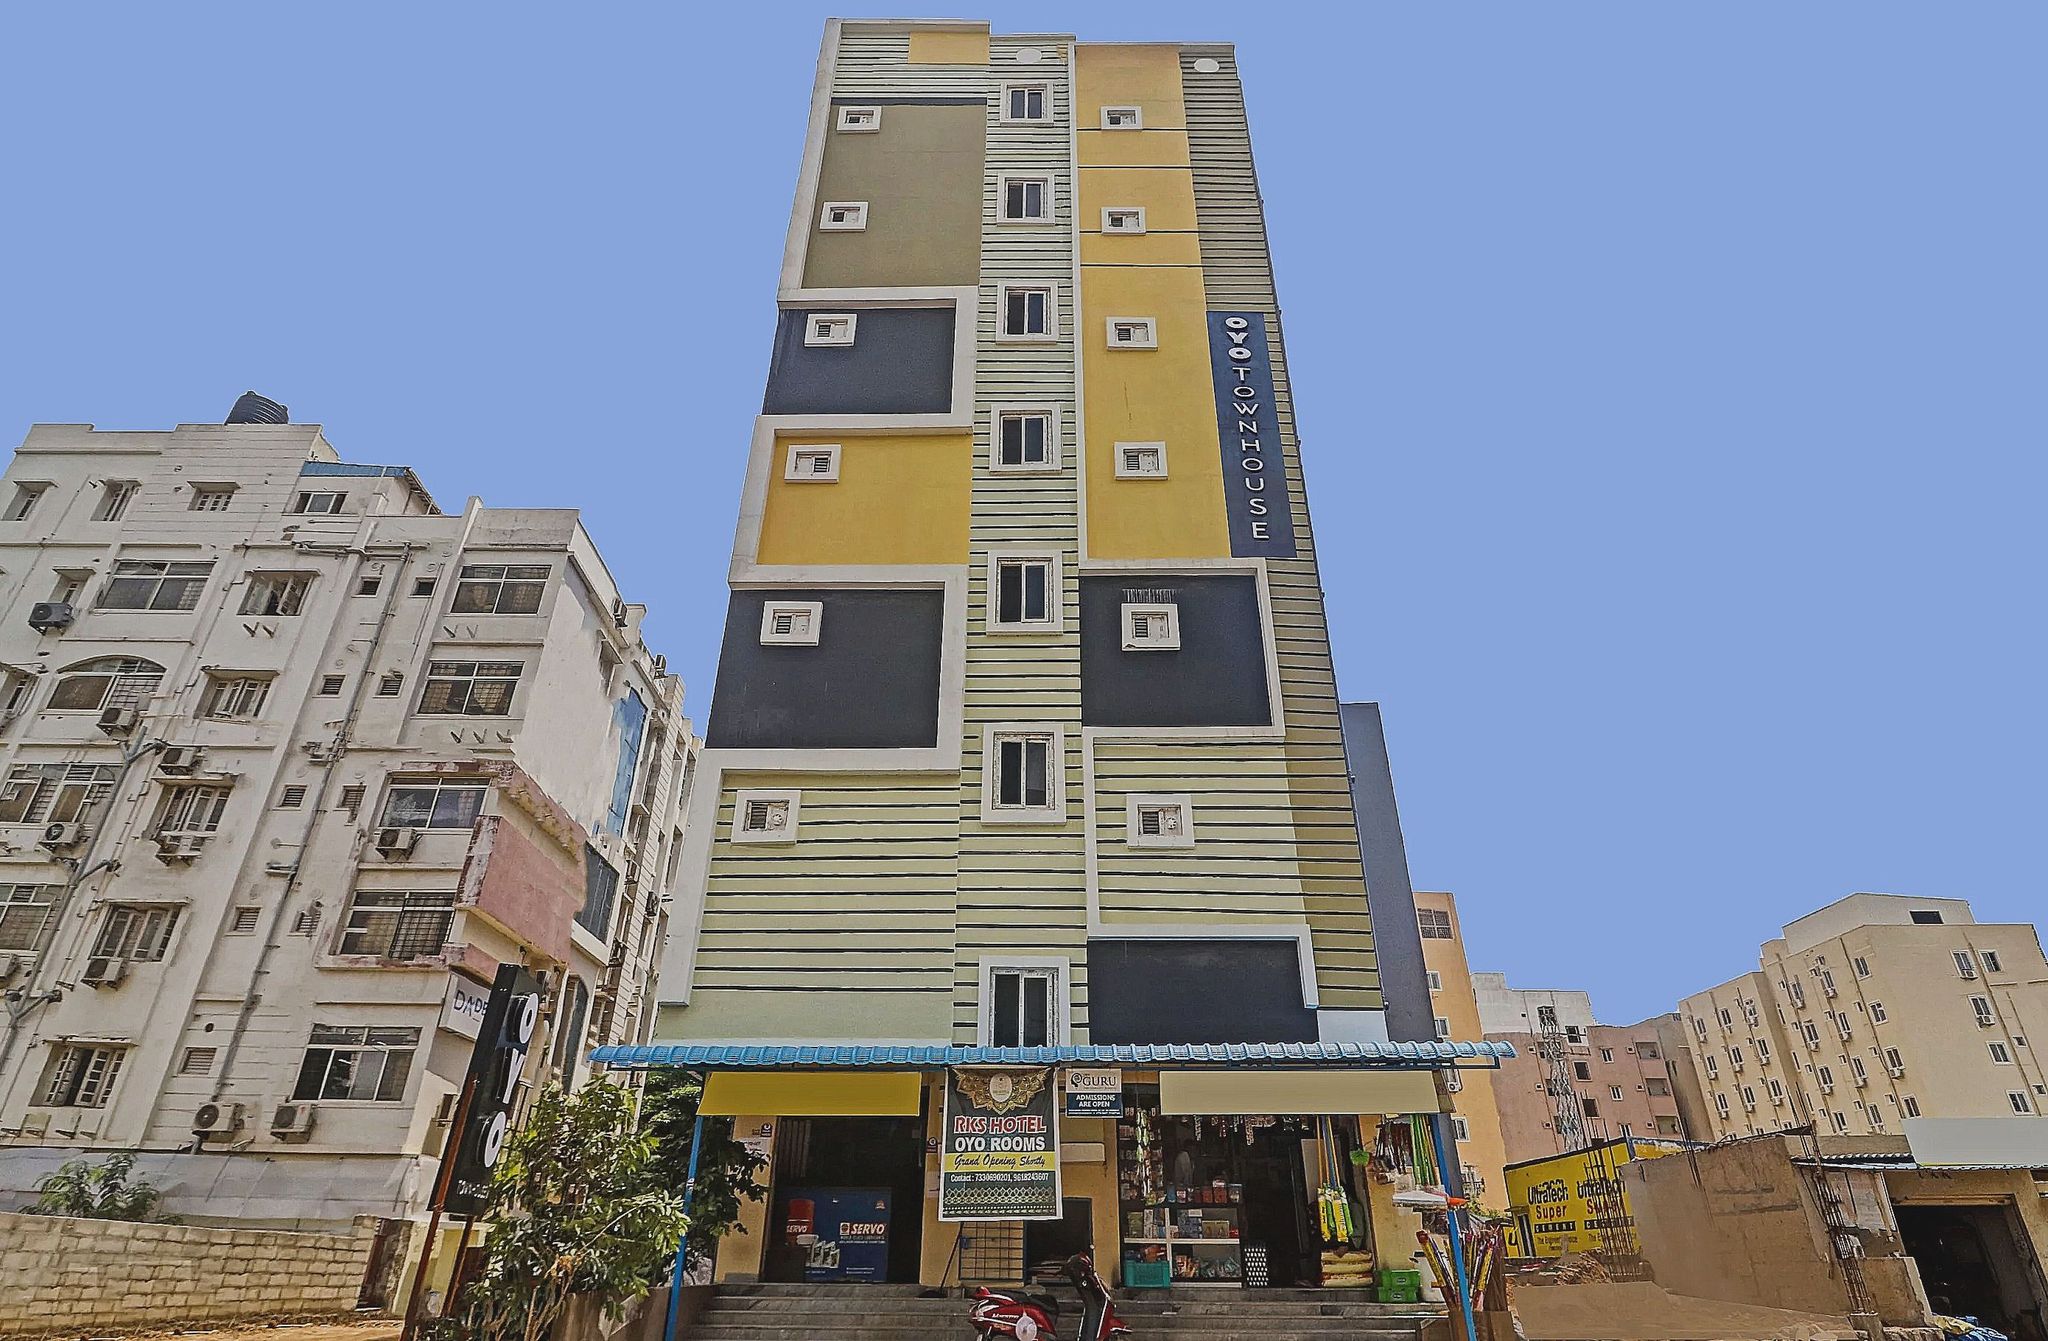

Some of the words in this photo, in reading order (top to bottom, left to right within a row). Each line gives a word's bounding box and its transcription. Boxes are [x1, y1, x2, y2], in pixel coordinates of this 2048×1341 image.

[1225, 316, 1252, 362] OYO
[1232, 366, 1270, 540] TOWNHOUSE
[484, 992, 539, 1168] OYO
[1075, 1094, 1116, 1102] ADMISSIONS
[954, 1115, 987, 1134] RKS
[989, 1115, 1047, 1134] HOTEL
[955, 1136, 986, 1152] OYO
[990, 1136, 1046, 1152] ROOMS
[954, 1153, 981, 1170] Grand
[982, 1153, 1016, 1170] Opening
[1019, 1155, 1046, 1168] Shortly
[1536, 1204, 1567, 1221] Super
[850, 1223, 886, 1235] SERVO
[1535, 1222, 1574, 1233] CEMENT
